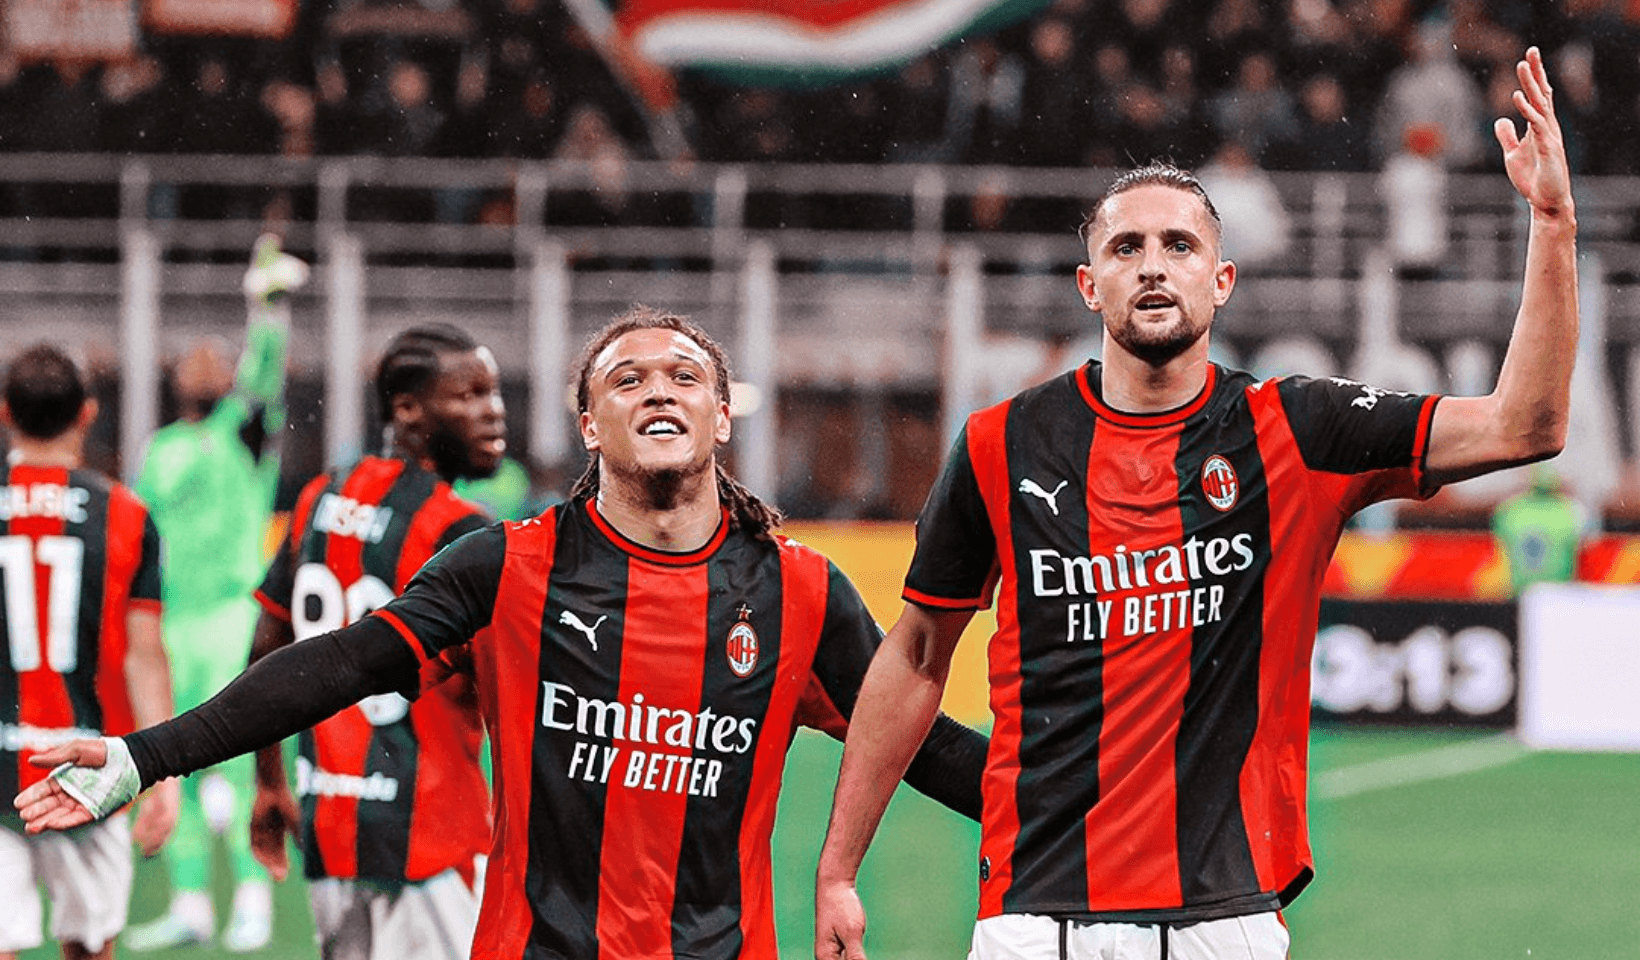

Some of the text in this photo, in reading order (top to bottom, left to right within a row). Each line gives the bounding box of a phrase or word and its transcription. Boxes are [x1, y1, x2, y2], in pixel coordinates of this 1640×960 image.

[1029, 532, 1255, 598] Emirates
[0, 535, 84, 673] 11
[1066, 584, 1225, 643] FLY BETTER
[541, 680, 757, 755] Emirates
[567, 740, 724, 798] FLY BETTER
